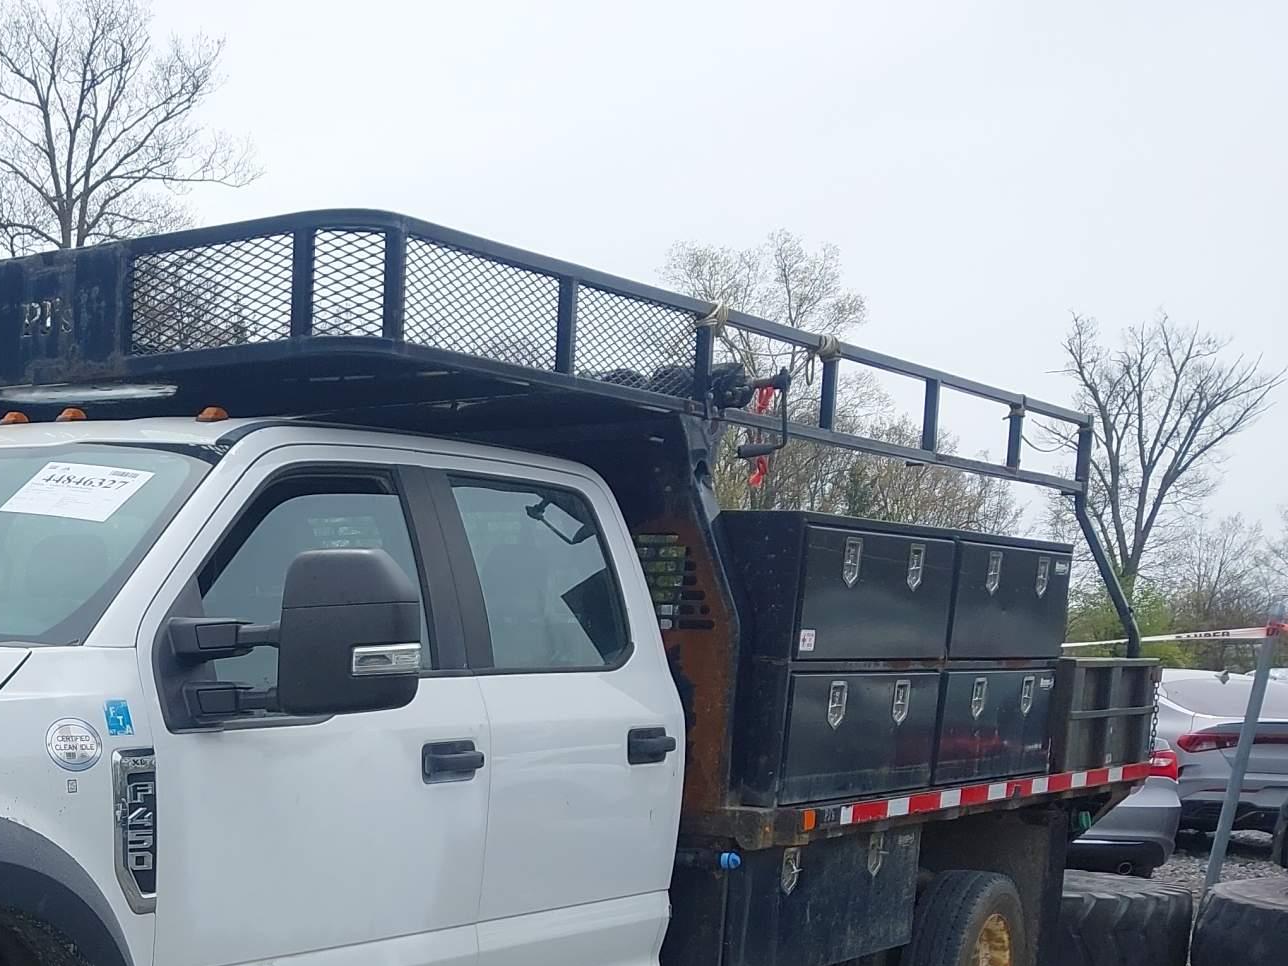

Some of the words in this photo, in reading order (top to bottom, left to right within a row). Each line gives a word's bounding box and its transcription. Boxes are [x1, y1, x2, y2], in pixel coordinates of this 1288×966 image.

[42, 473, 129, 490] 44846327
[55, 743, 77, 751] CLEAN
[80, 743, 95, 751] IDLE
